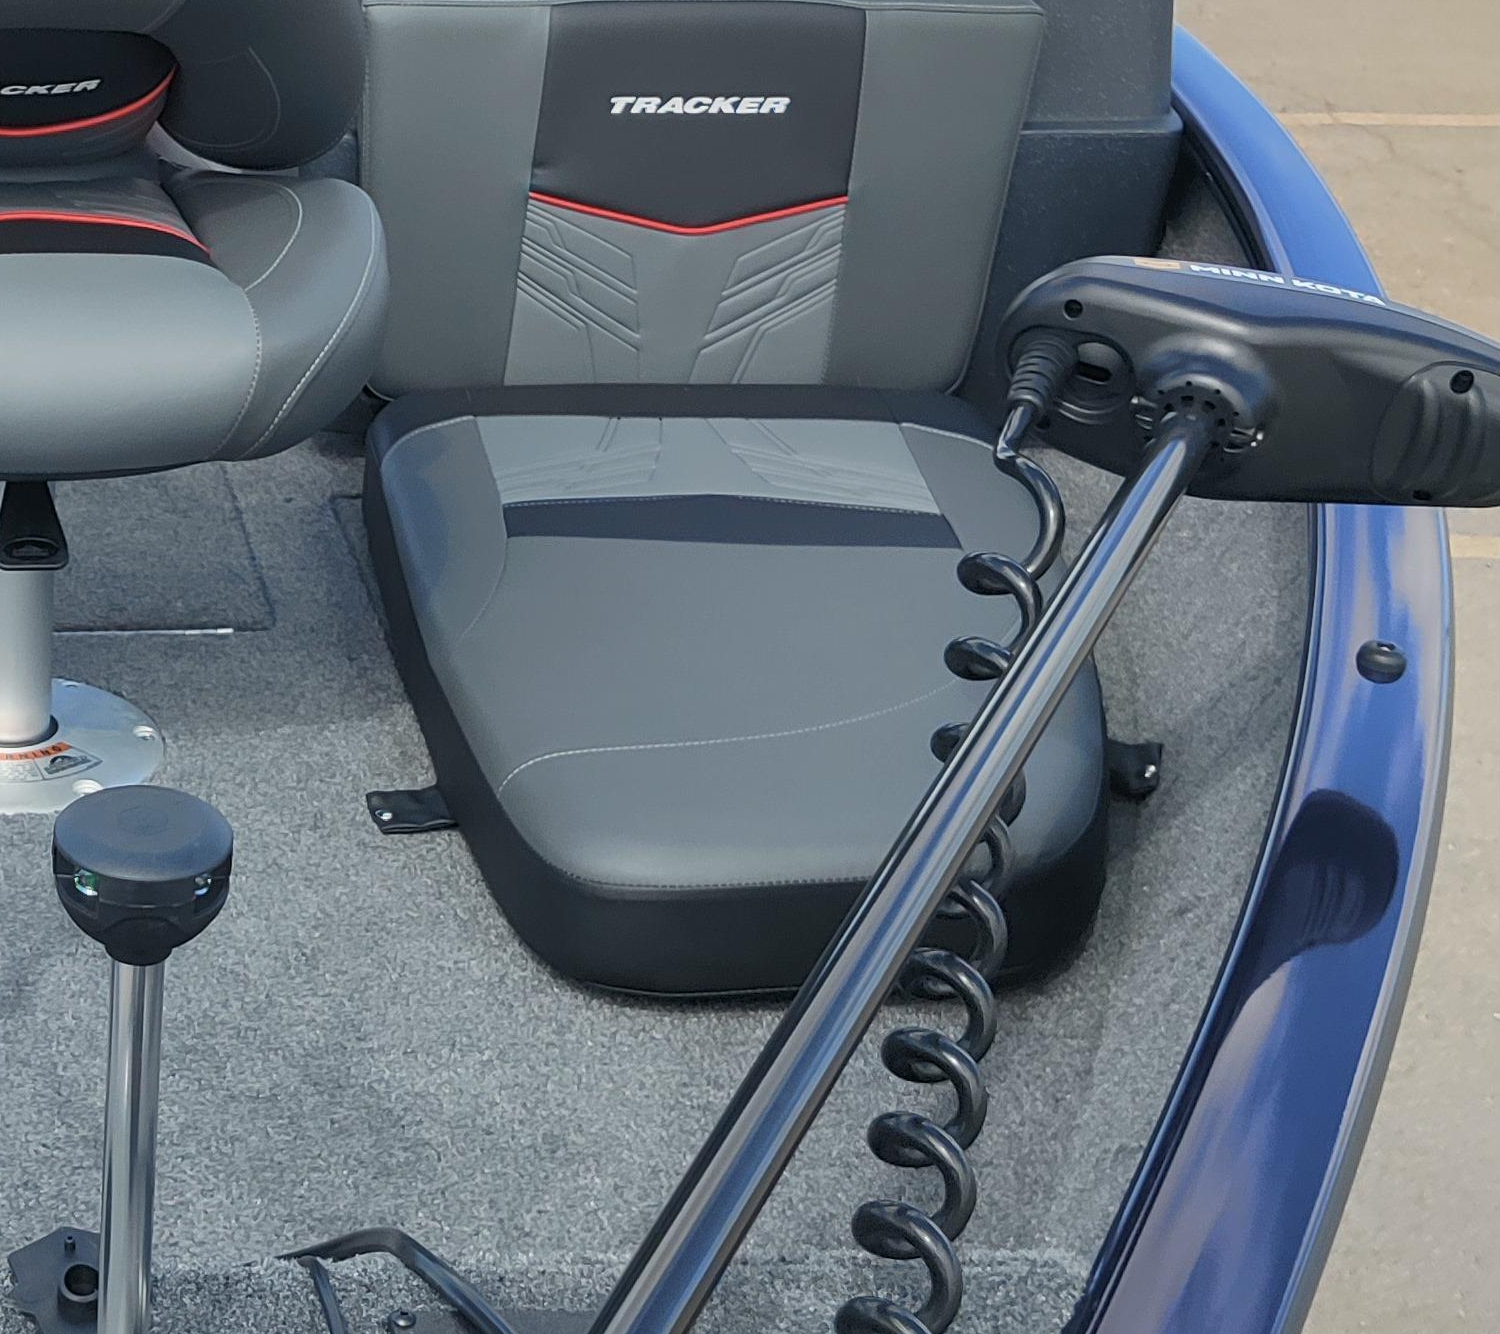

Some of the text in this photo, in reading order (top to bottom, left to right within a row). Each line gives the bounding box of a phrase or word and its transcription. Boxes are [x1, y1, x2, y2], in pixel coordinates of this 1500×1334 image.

[610, 96, 791, 115] TRACKER
[1190, 264, 1386, 307] MINN KOTA
